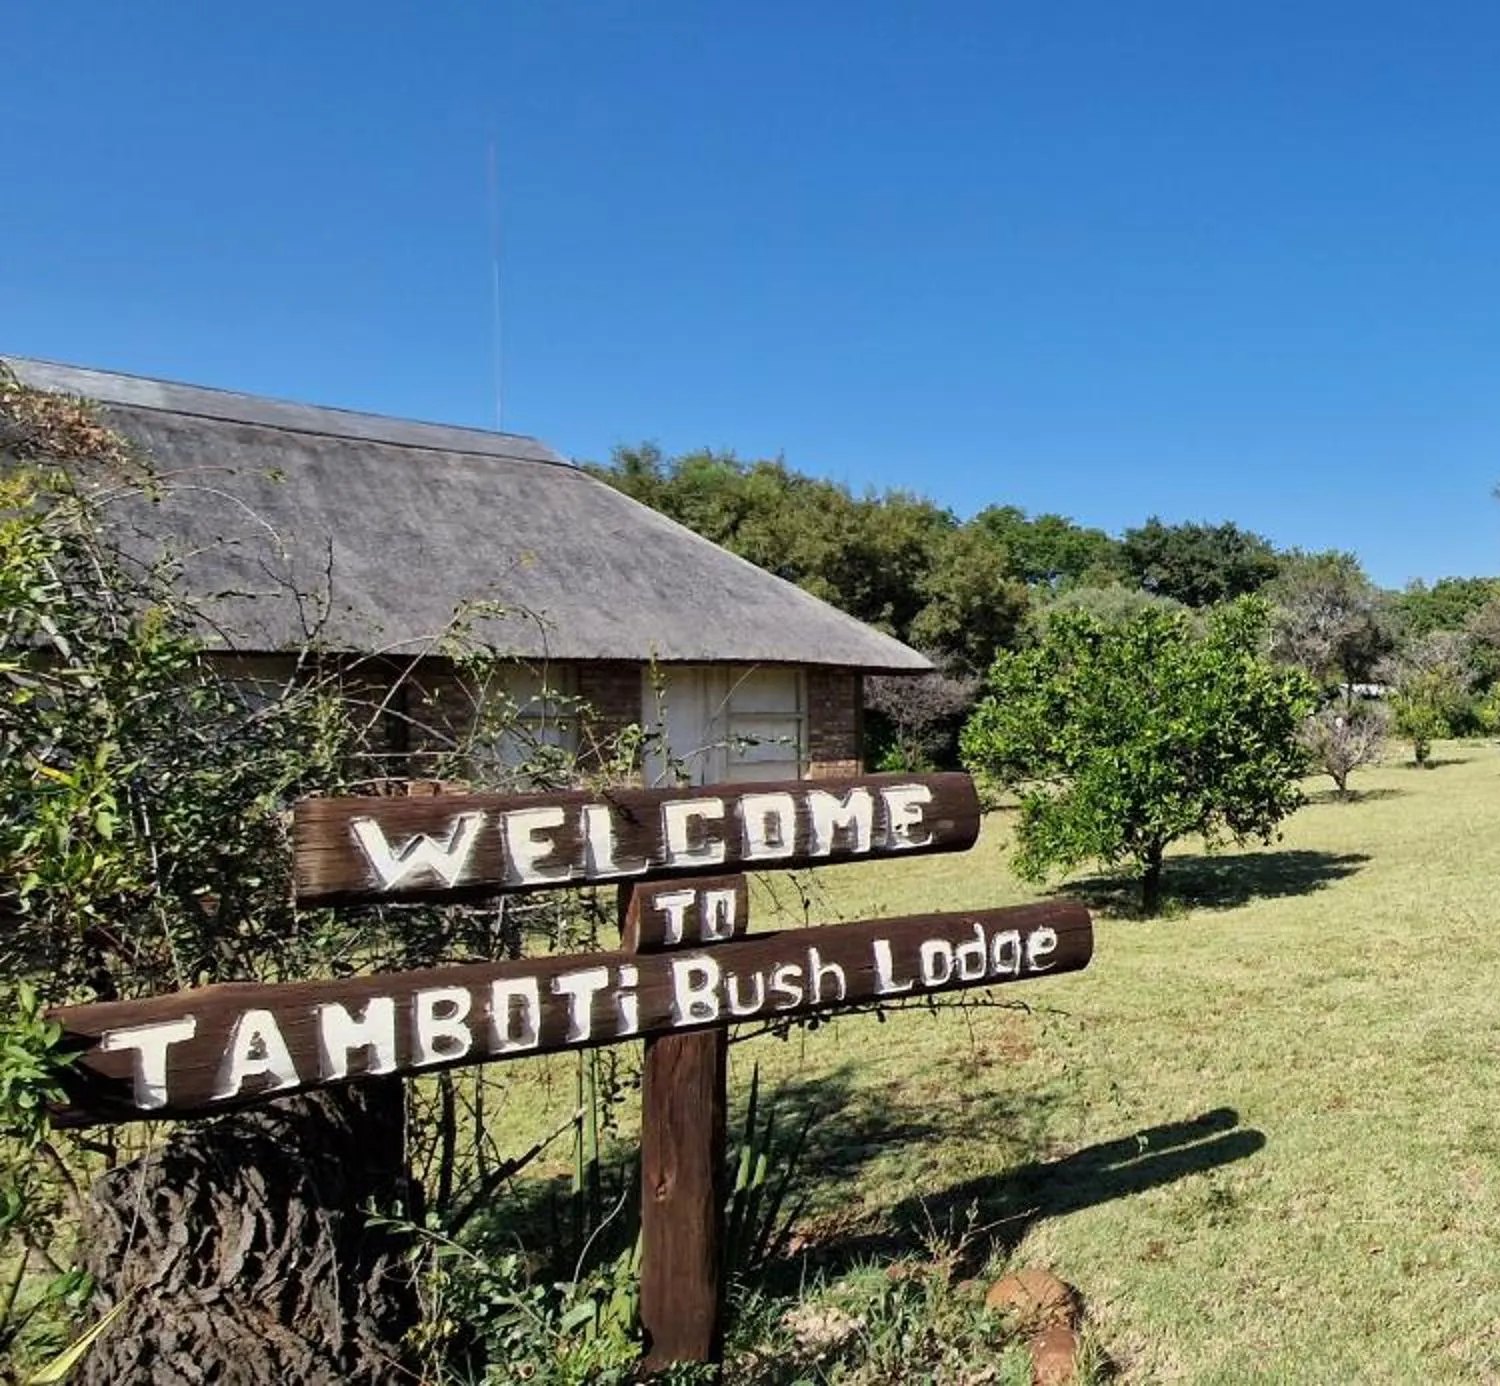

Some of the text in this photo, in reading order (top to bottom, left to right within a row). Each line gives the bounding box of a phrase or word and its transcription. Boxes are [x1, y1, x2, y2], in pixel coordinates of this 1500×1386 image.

[350, 783, 934, 891] WELCOME
[654, 889, 737, 945] TO
[670, 953, 846, 1028] Bush
[872, 922, 1058, 995] Lodge
